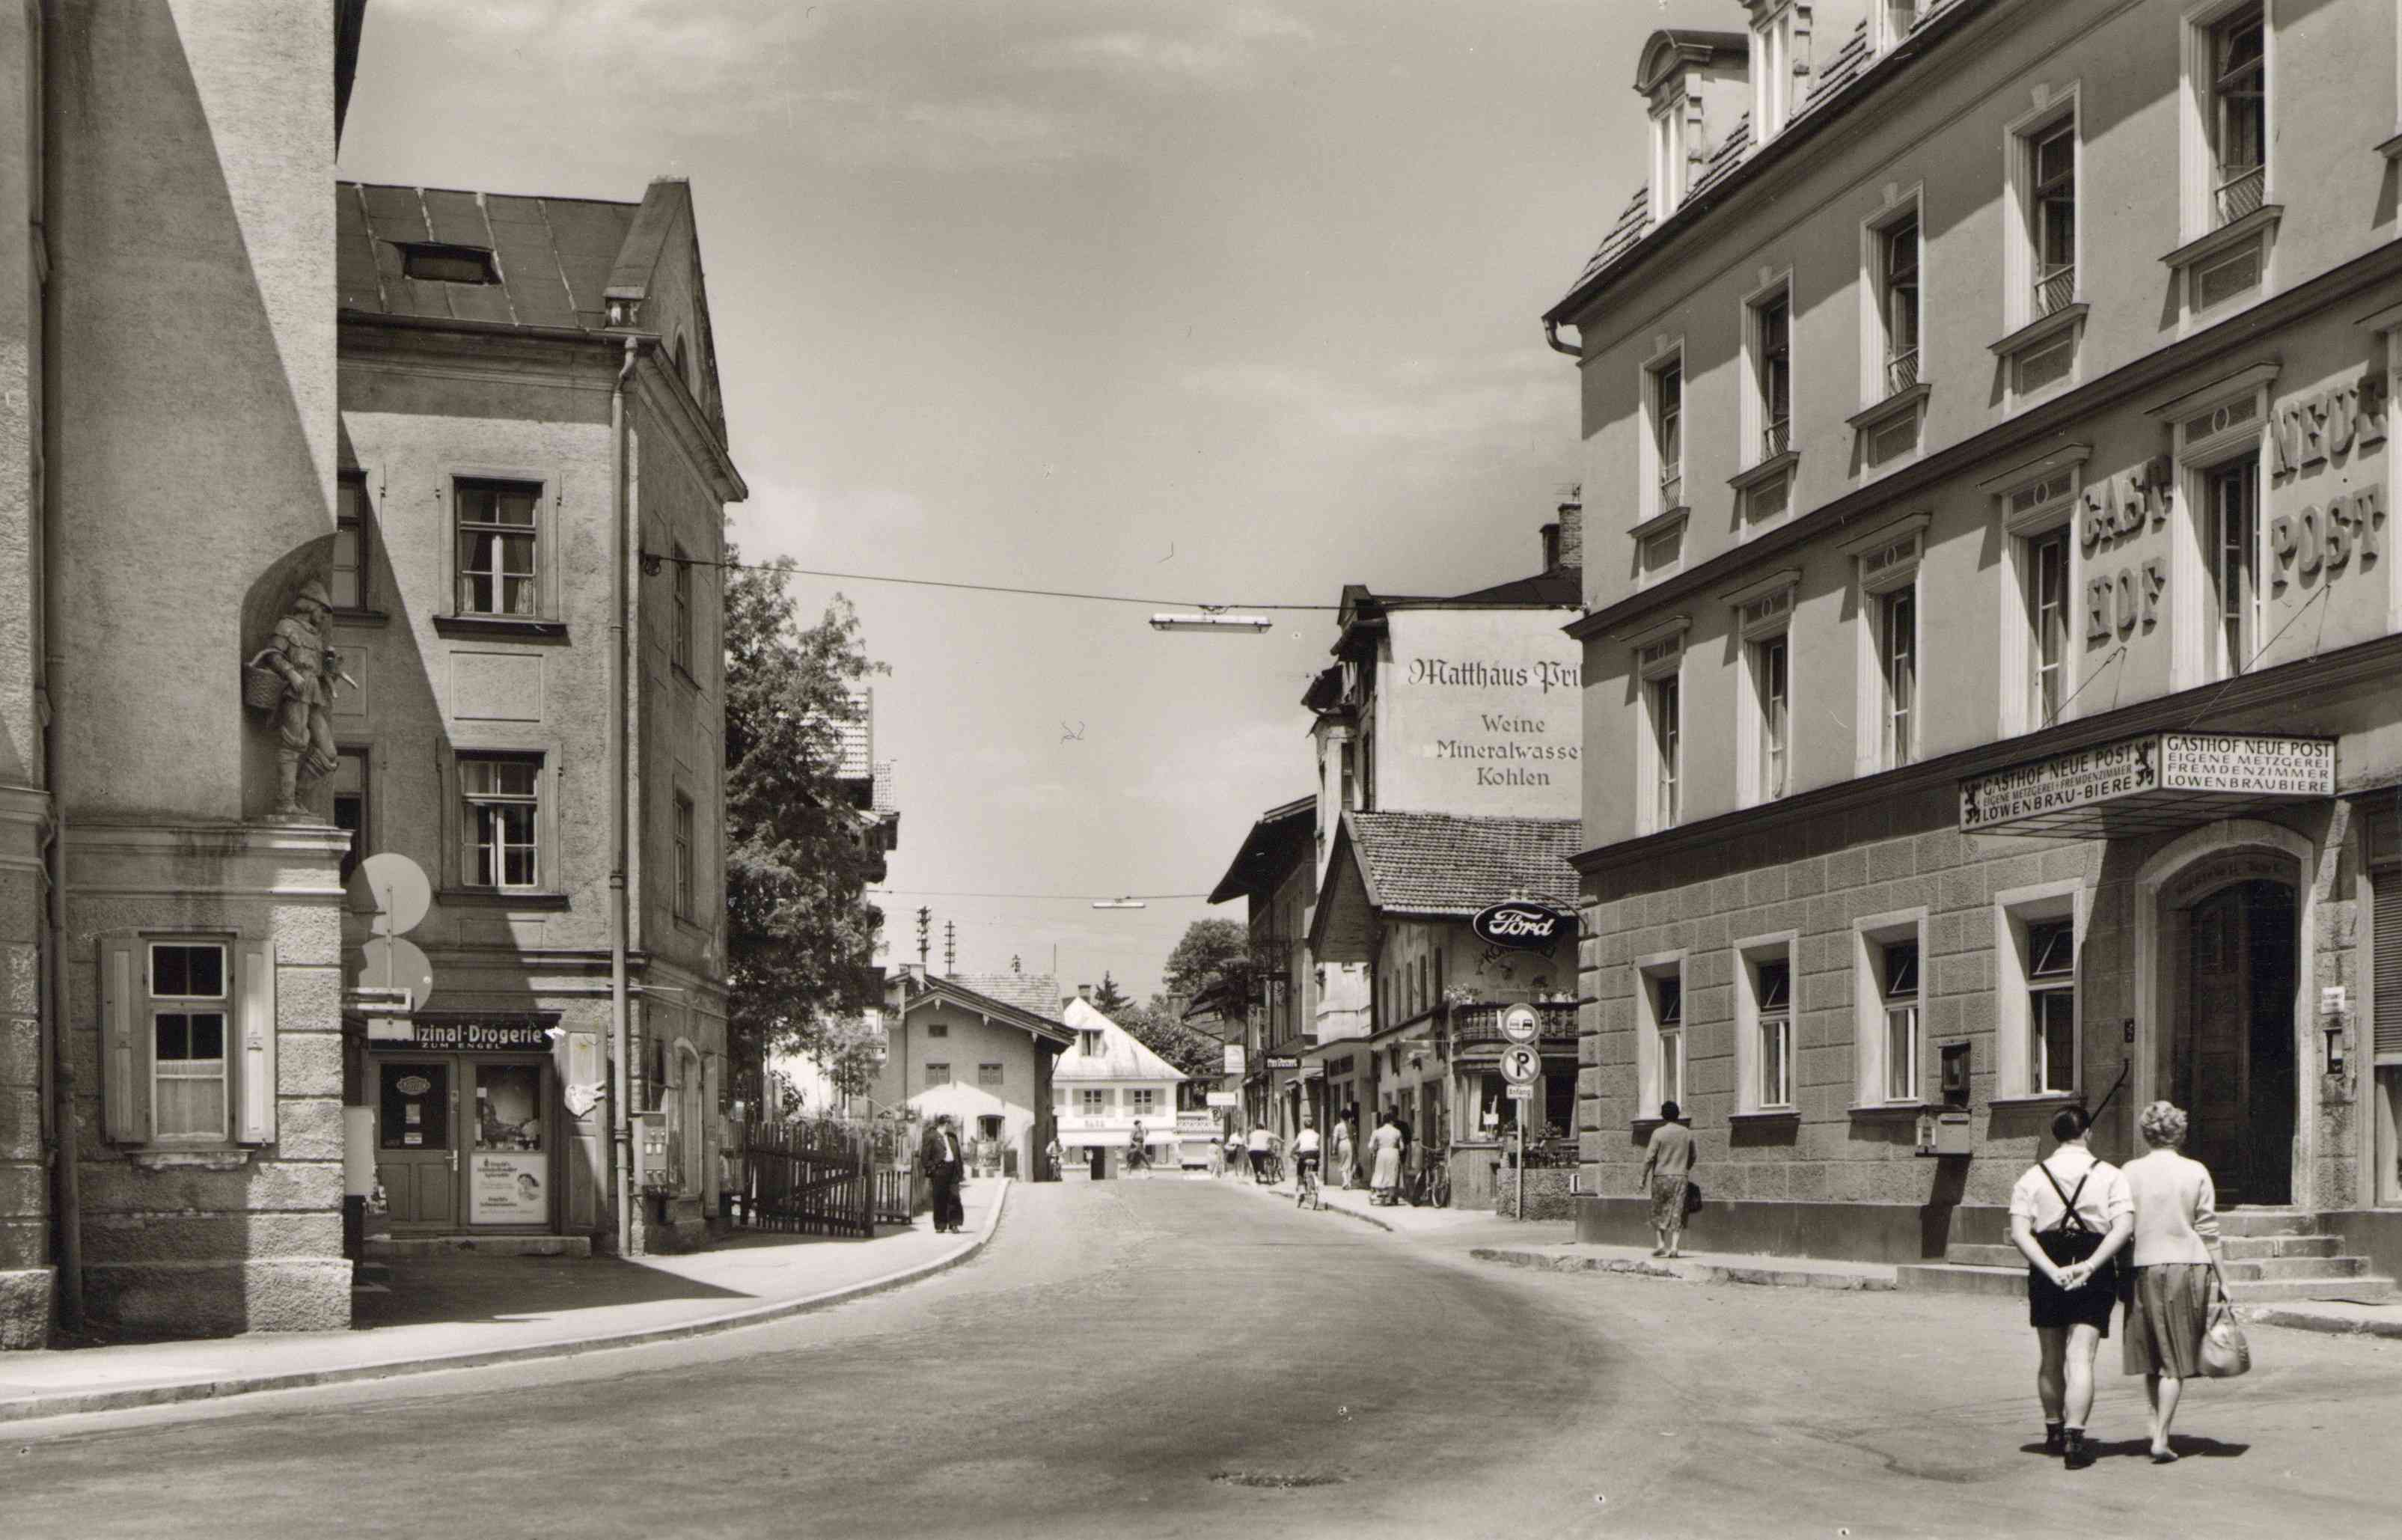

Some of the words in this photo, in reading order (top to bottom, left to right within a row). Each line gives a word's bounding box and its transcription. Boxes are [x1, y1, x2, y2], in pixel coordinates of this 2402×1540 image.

[2272, 374, 2389, 478] NEUE
[2080, 456, 2174, 547] GAST
[2271, 484, 2386, 587] POST
[2087, 557, 2166, 641] HOF
[1408, 657, 1528, 689] Matthäus
[1533, 661, 1582, 694] Pri
[1482, 714, 1545, 733] Weine
[1437, 739, 1582, 760] Mineralwasse
[2167, 736, 2240, 754] GASTHOF
[2245, 739, 2286, 756] NEUE
[2291, 742, 2330, 758] POST
[1983, 766, 2044, 795] GASTHOF
[2050, 754, 2089, 779] NEUE
[2094, 744, 2133, 769] POST
[2168, 752, 2231, 764] EIGENE
[2237, 755, 2329, 769] METZGEREI
[2168, 763, 2329, 779] FREMDENZIMMER
[1476, 767, 1550, 786] Kohlen
[1489, 909, 1556, 937] Ford
[1517, 1052, 1529, 1077] P
